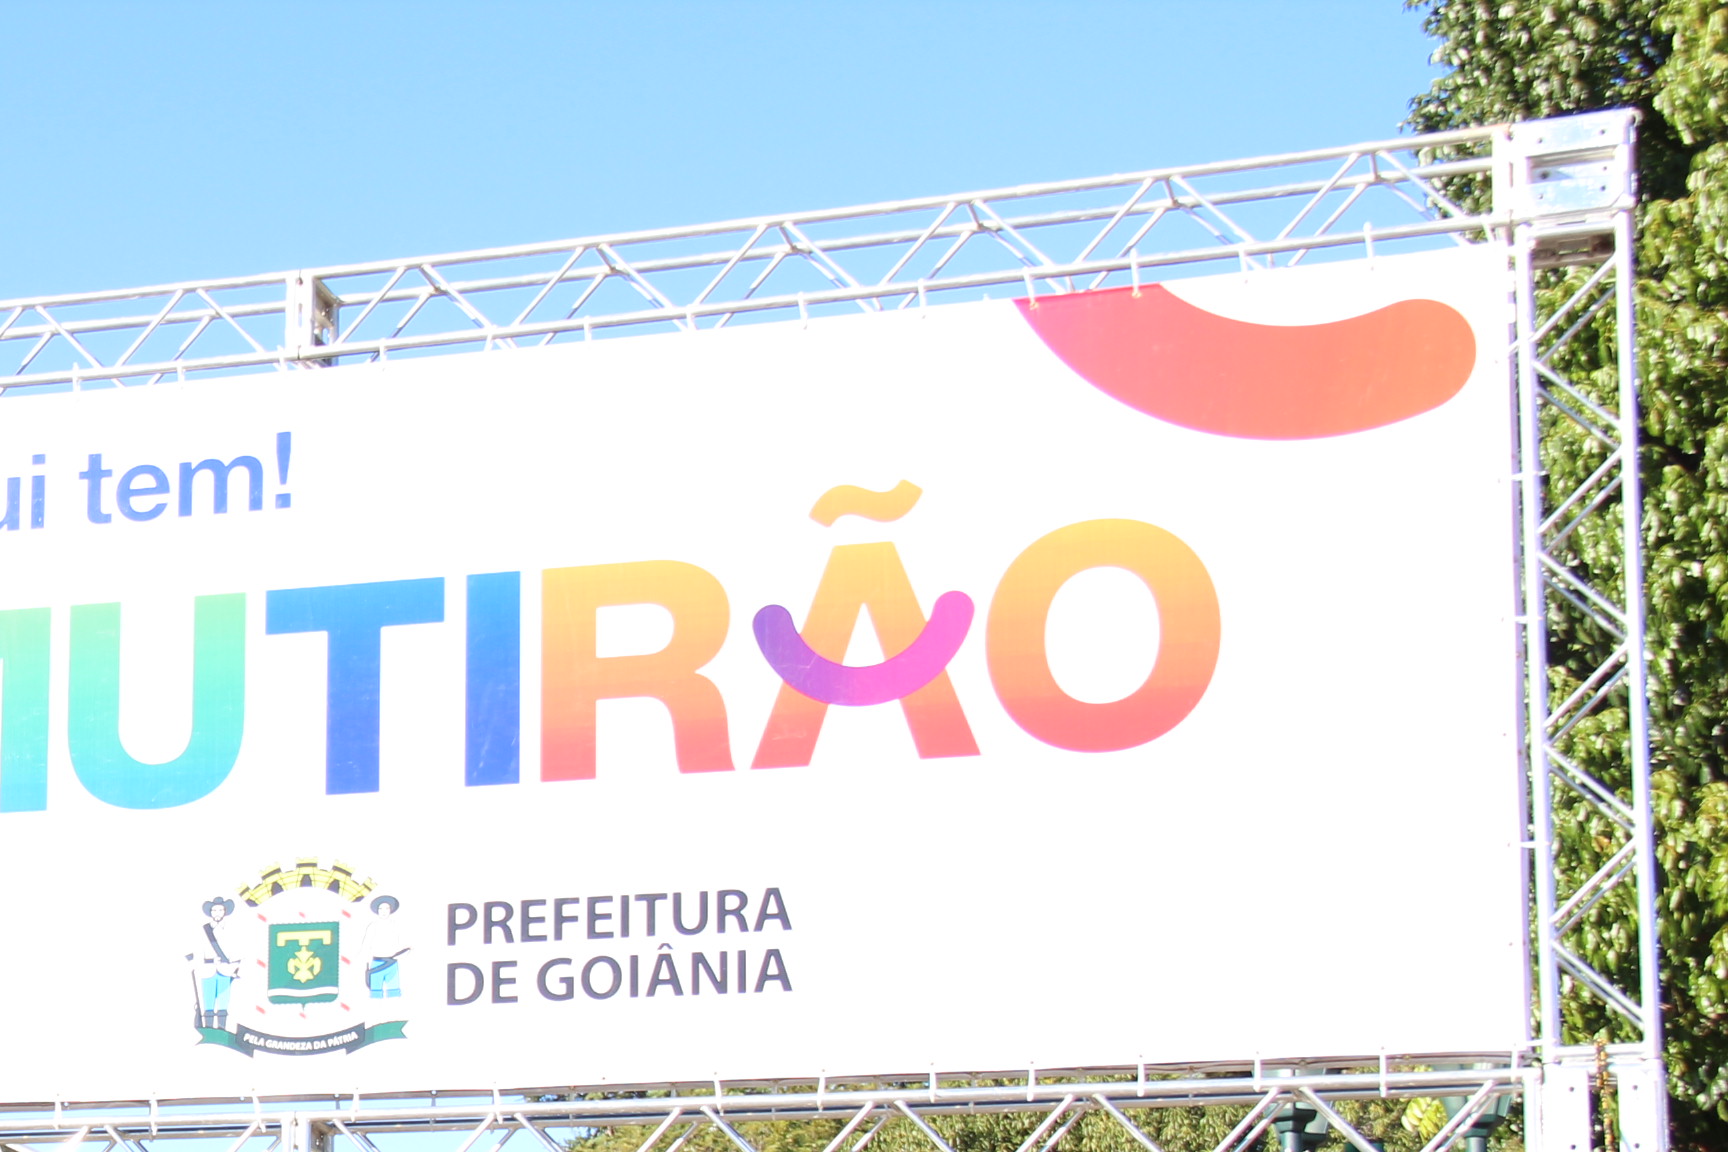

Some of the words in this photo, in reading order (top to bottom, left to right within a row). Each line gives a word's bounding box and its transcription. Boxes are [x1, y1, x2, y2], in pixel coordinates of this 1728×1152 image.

[78, 431, 292, 525] tem!
[448, 887, 793, 946] PREFEITURA
[447, 960, 519, 1006] DE
[537, 943, 793, 1002] GOIÂNIA
[243, 1033, 265, 1047] PELA
[265, 1039, 313, 1051] GRANDEZA
[313, 1040, 327, 1050] DA
[327, 1031, 359, 1047] PÁTRIA
